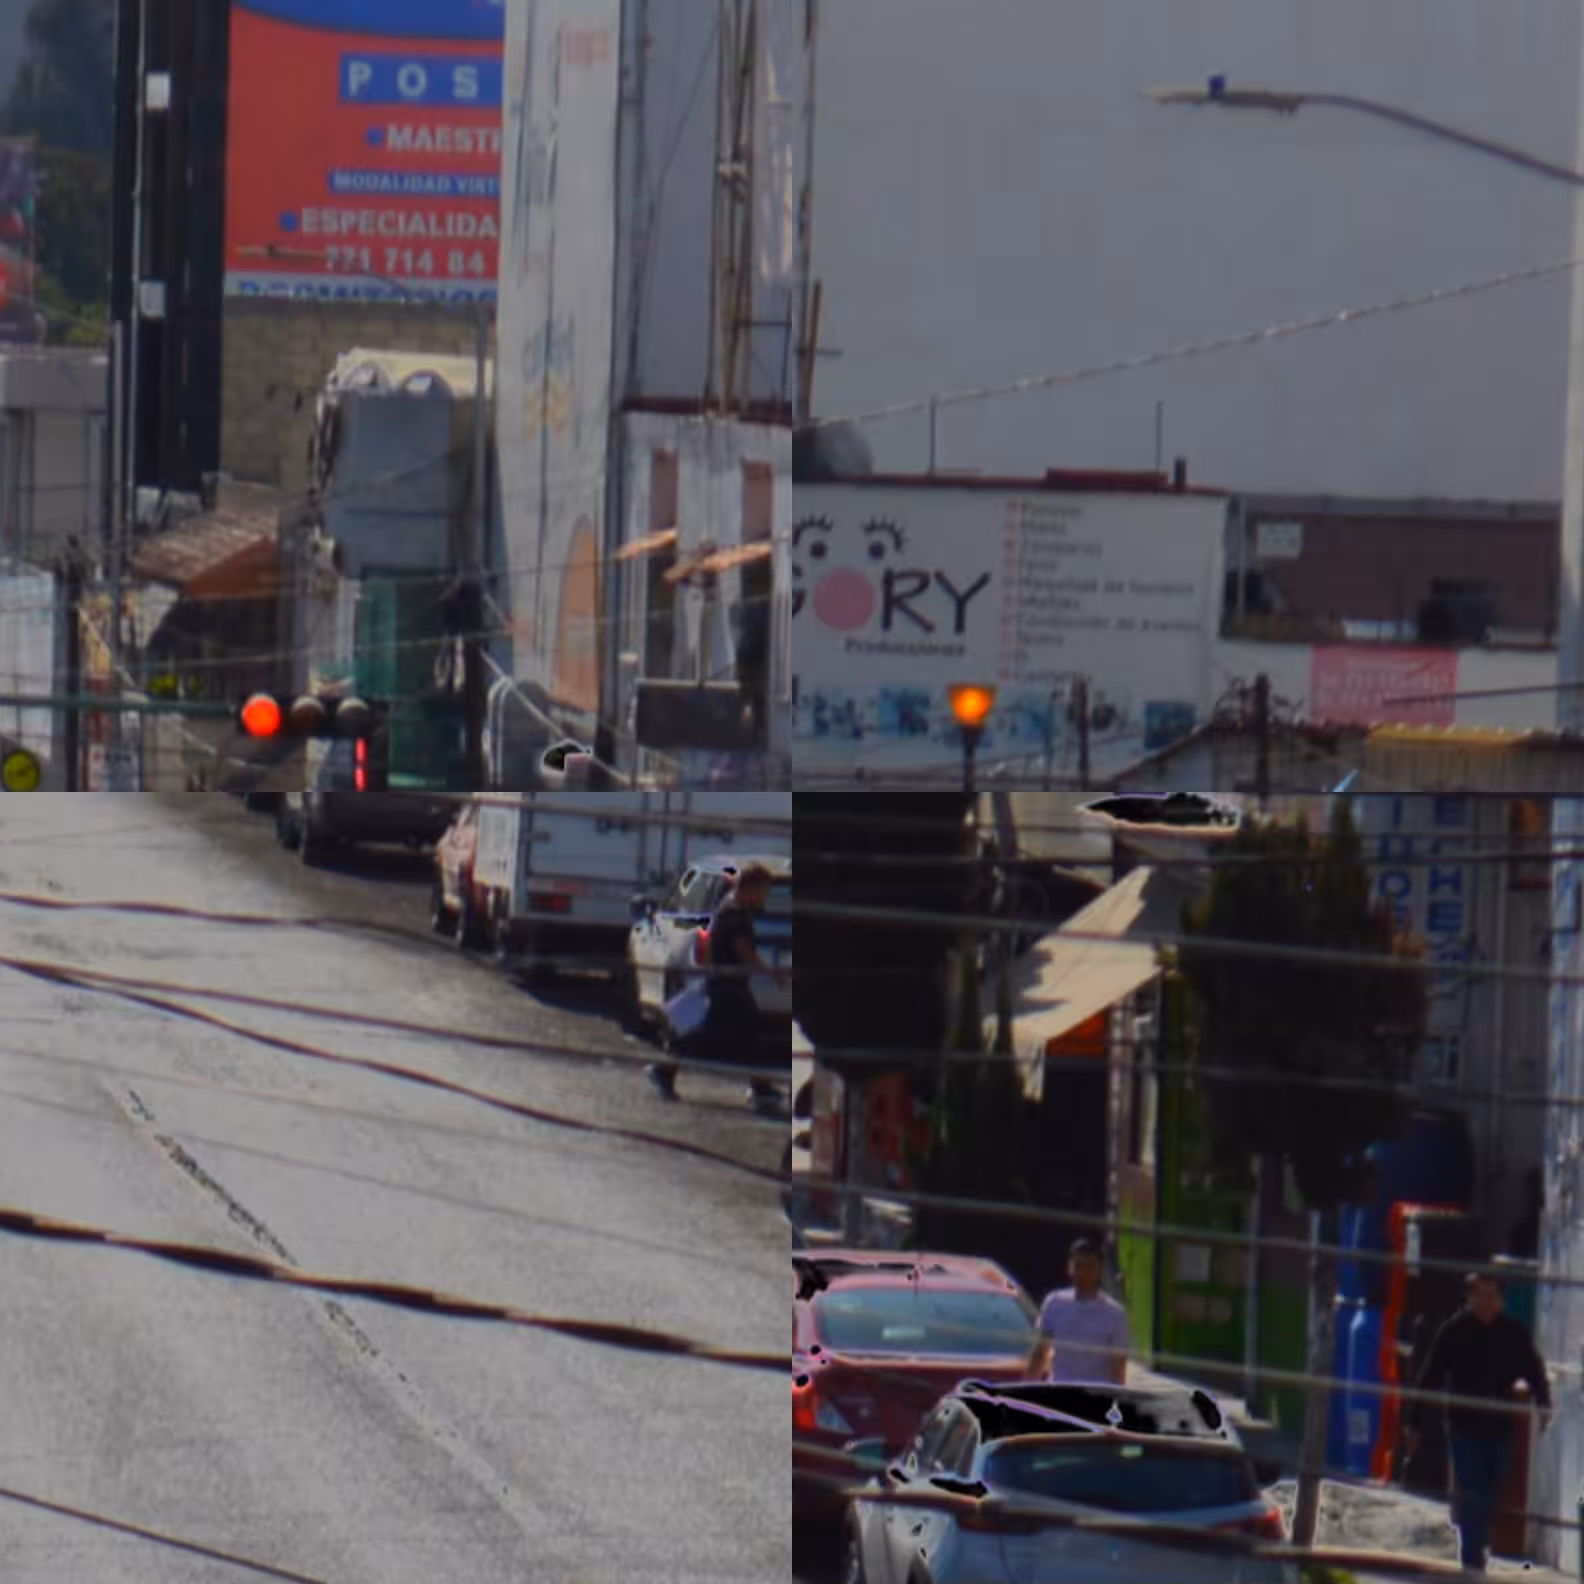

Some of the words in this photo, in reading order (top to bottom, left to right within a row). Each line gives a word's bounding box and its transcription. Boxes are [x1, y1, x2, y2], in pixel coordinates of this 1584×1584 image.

[330, 171, 451, 195] MODALIDAD
[455, 175, 500, 197] VIRT
[300, 208, 498, 239] ESPECIALIDA
[383, 247, 434, 275] 714
